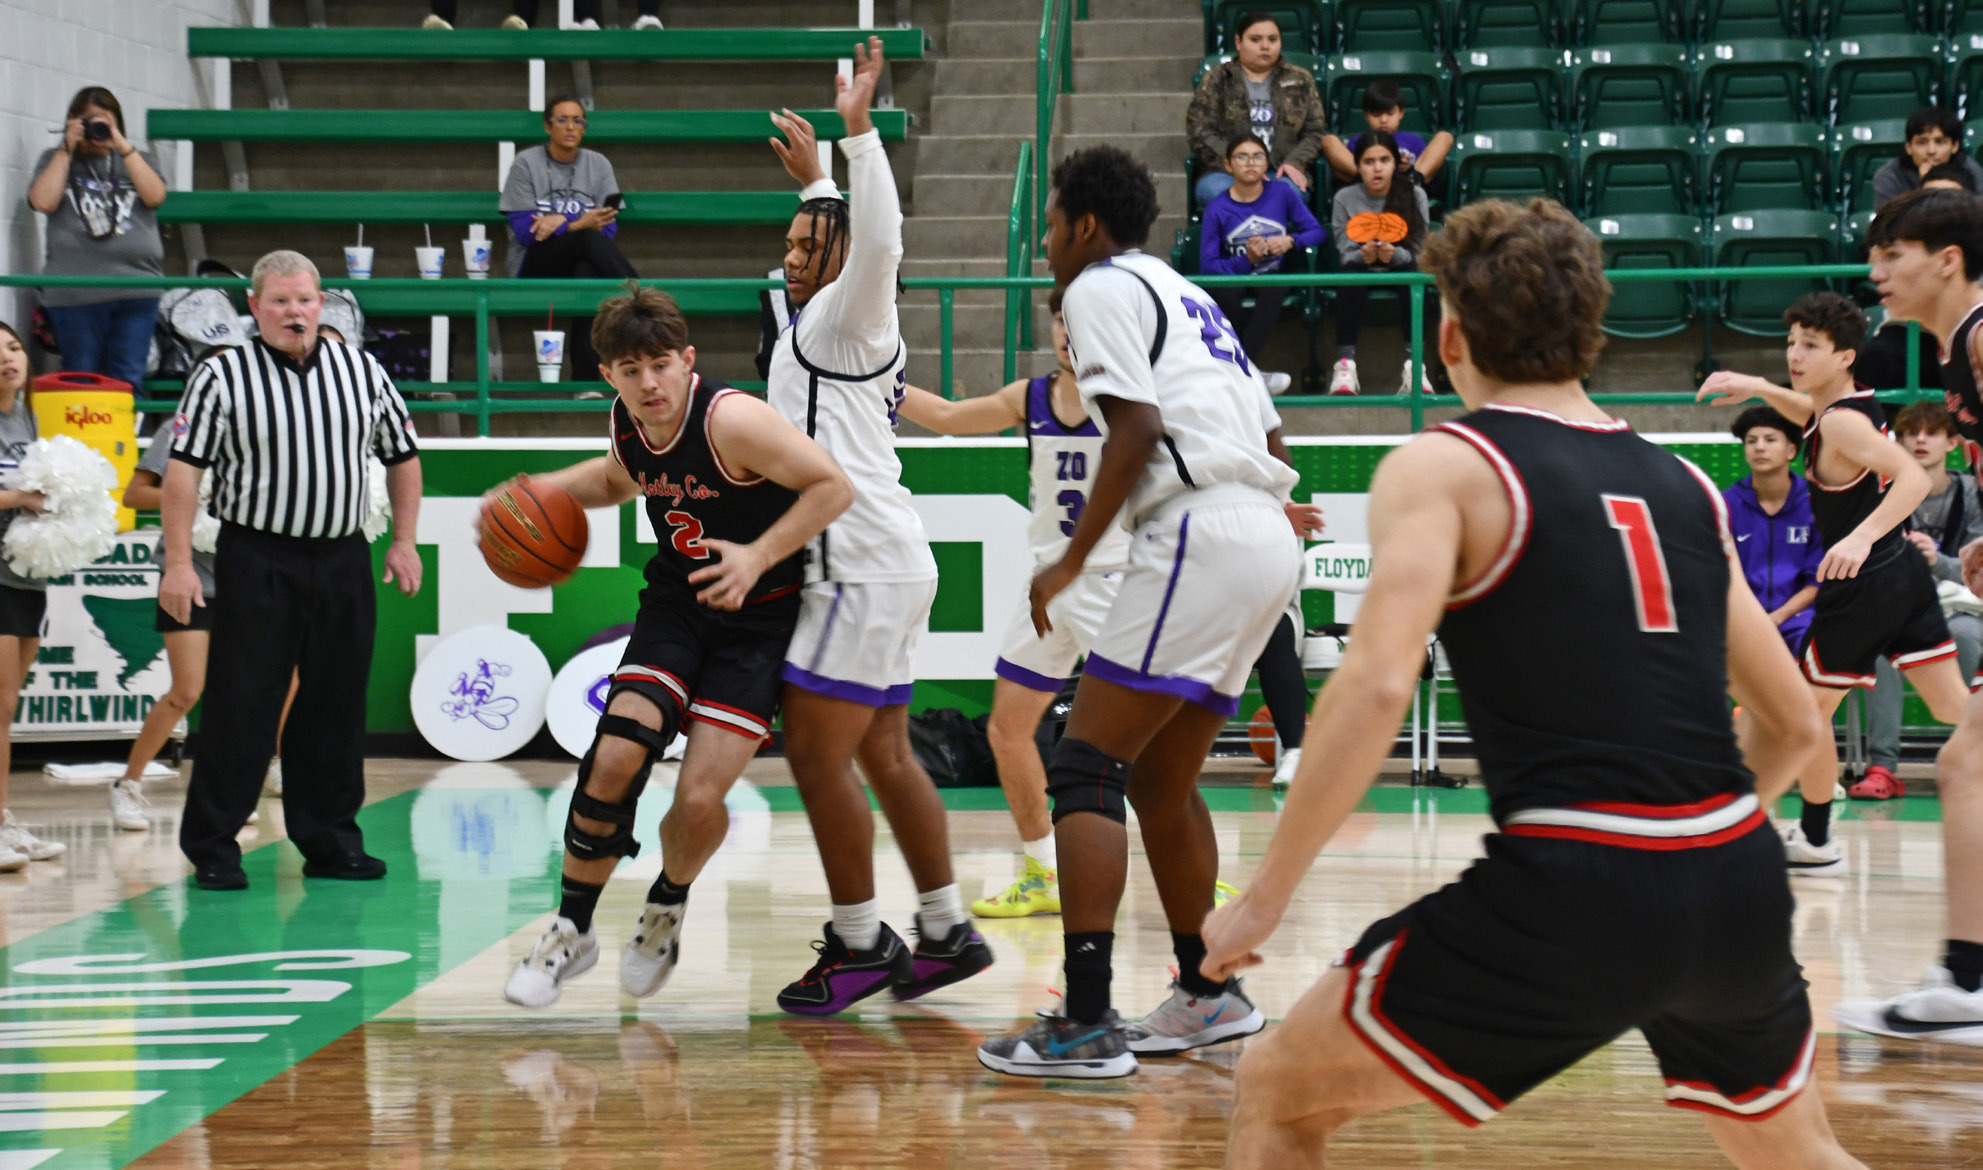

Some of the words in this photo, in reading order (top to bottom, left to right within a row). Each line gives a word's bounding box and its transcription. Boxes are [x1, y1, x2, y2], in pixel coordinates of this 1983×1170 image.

[65, 405, 112, 430] igloo
[1056, 451, 1087, 481] ZO
[1057, 489, 1089, 538] 3
[664, 510, 710, 559] 2
[1600, 493, 1680, 633] 1
[83, 573, 148, 587] SCHOOL
[33, 646, 75, 665] ME
[48, 671, 98, 690] THE
